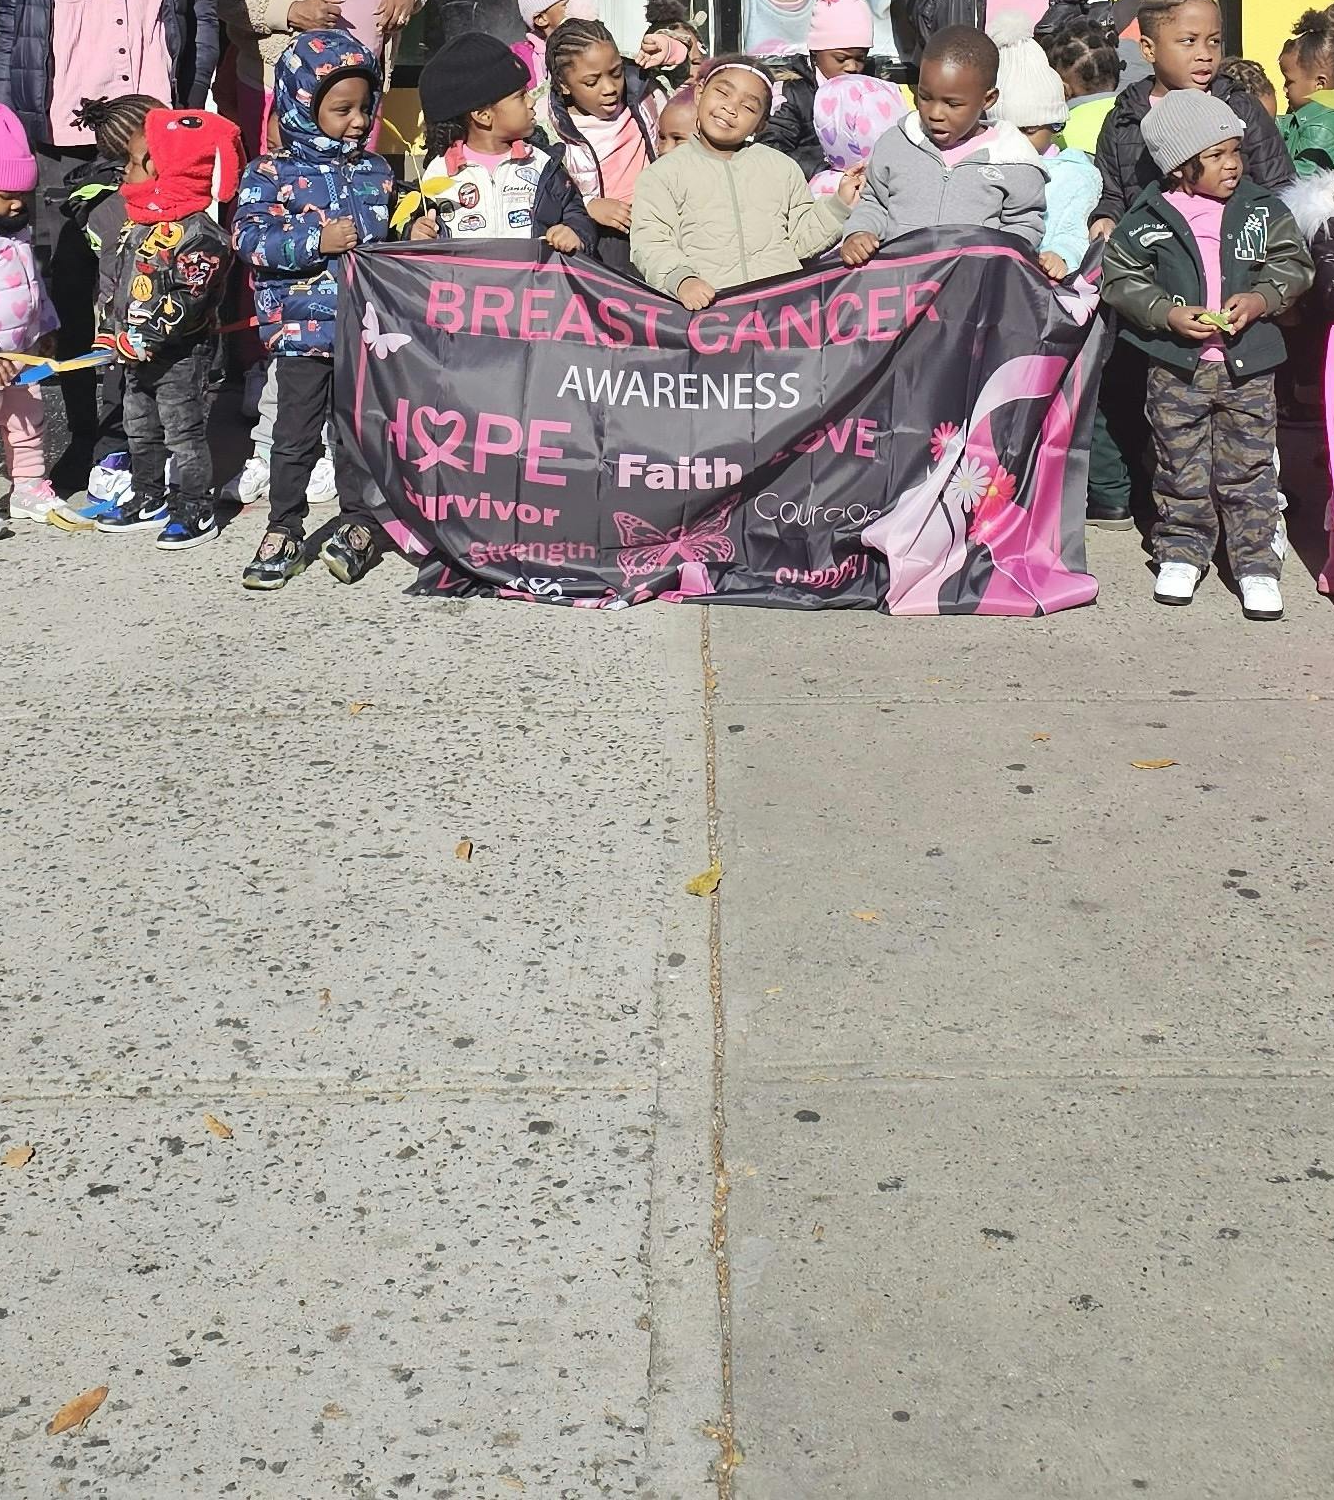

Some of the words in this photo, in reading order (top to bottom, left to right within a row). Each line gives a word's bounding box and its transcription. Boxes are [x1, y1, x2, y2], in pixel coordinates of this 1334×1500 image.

[424, 280, 673, 352] BREAST
[687, 280, 942, 356] CANCER
[556, 365, 801, 411] AWARENESS
[769, 417, 879, 467] OVE
[616, 453, 743, 491] Faith
[467, 539, 596, 568] Strength
